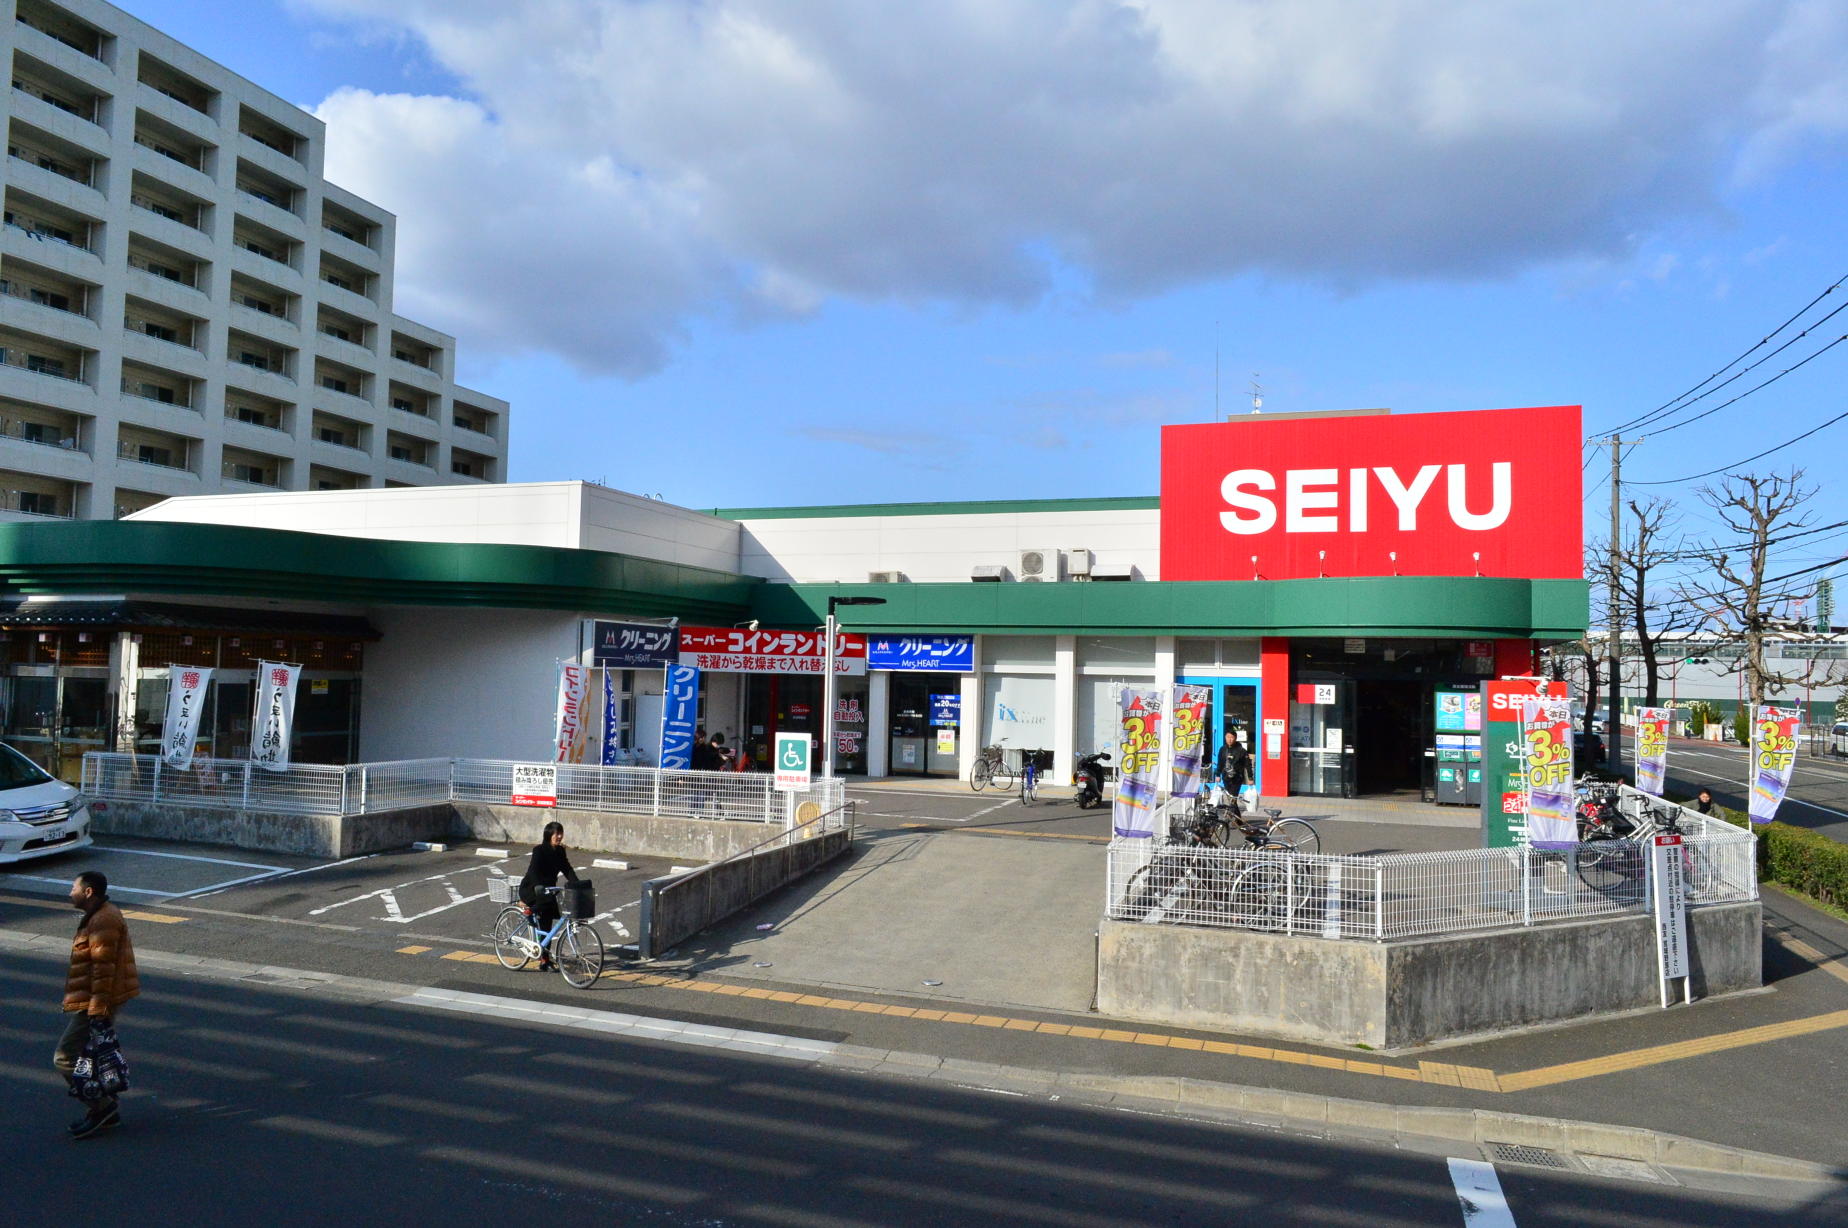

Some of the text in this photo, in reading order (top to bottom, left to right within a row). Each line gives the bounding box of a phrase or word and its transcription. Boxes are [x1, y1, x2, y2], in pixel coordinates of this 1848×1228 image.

[1219, 461, 1512, 535] SEIYU
[620, 629, 672, 652] クリーニング
[682, 631, 863, 656] スーパー コインランドリー
[899, 637, 970, 657] クリーニング
[1319, 688, 1332, 697] 24
[662, 666, 696, 770] クリーニング
[1174, 708, 1204, 737] 3%
[1549, 710, 1567, 720] 本日
[1121, 717, 1160, 754] 3%
[1639, 723, 1667, 745] 3%
[1757, 721, 1796, 752] 3%
[1527, 729, 1570, 767] 3%
[1639, 744, 1666, 758] OFF
[515, 766, 554, 777] 大型洗濯物
[1121, 752, 1160, 775] OFF
[1758, 751, 1793, 771] OFF
[1529, 762, 1570, 788] OFF
